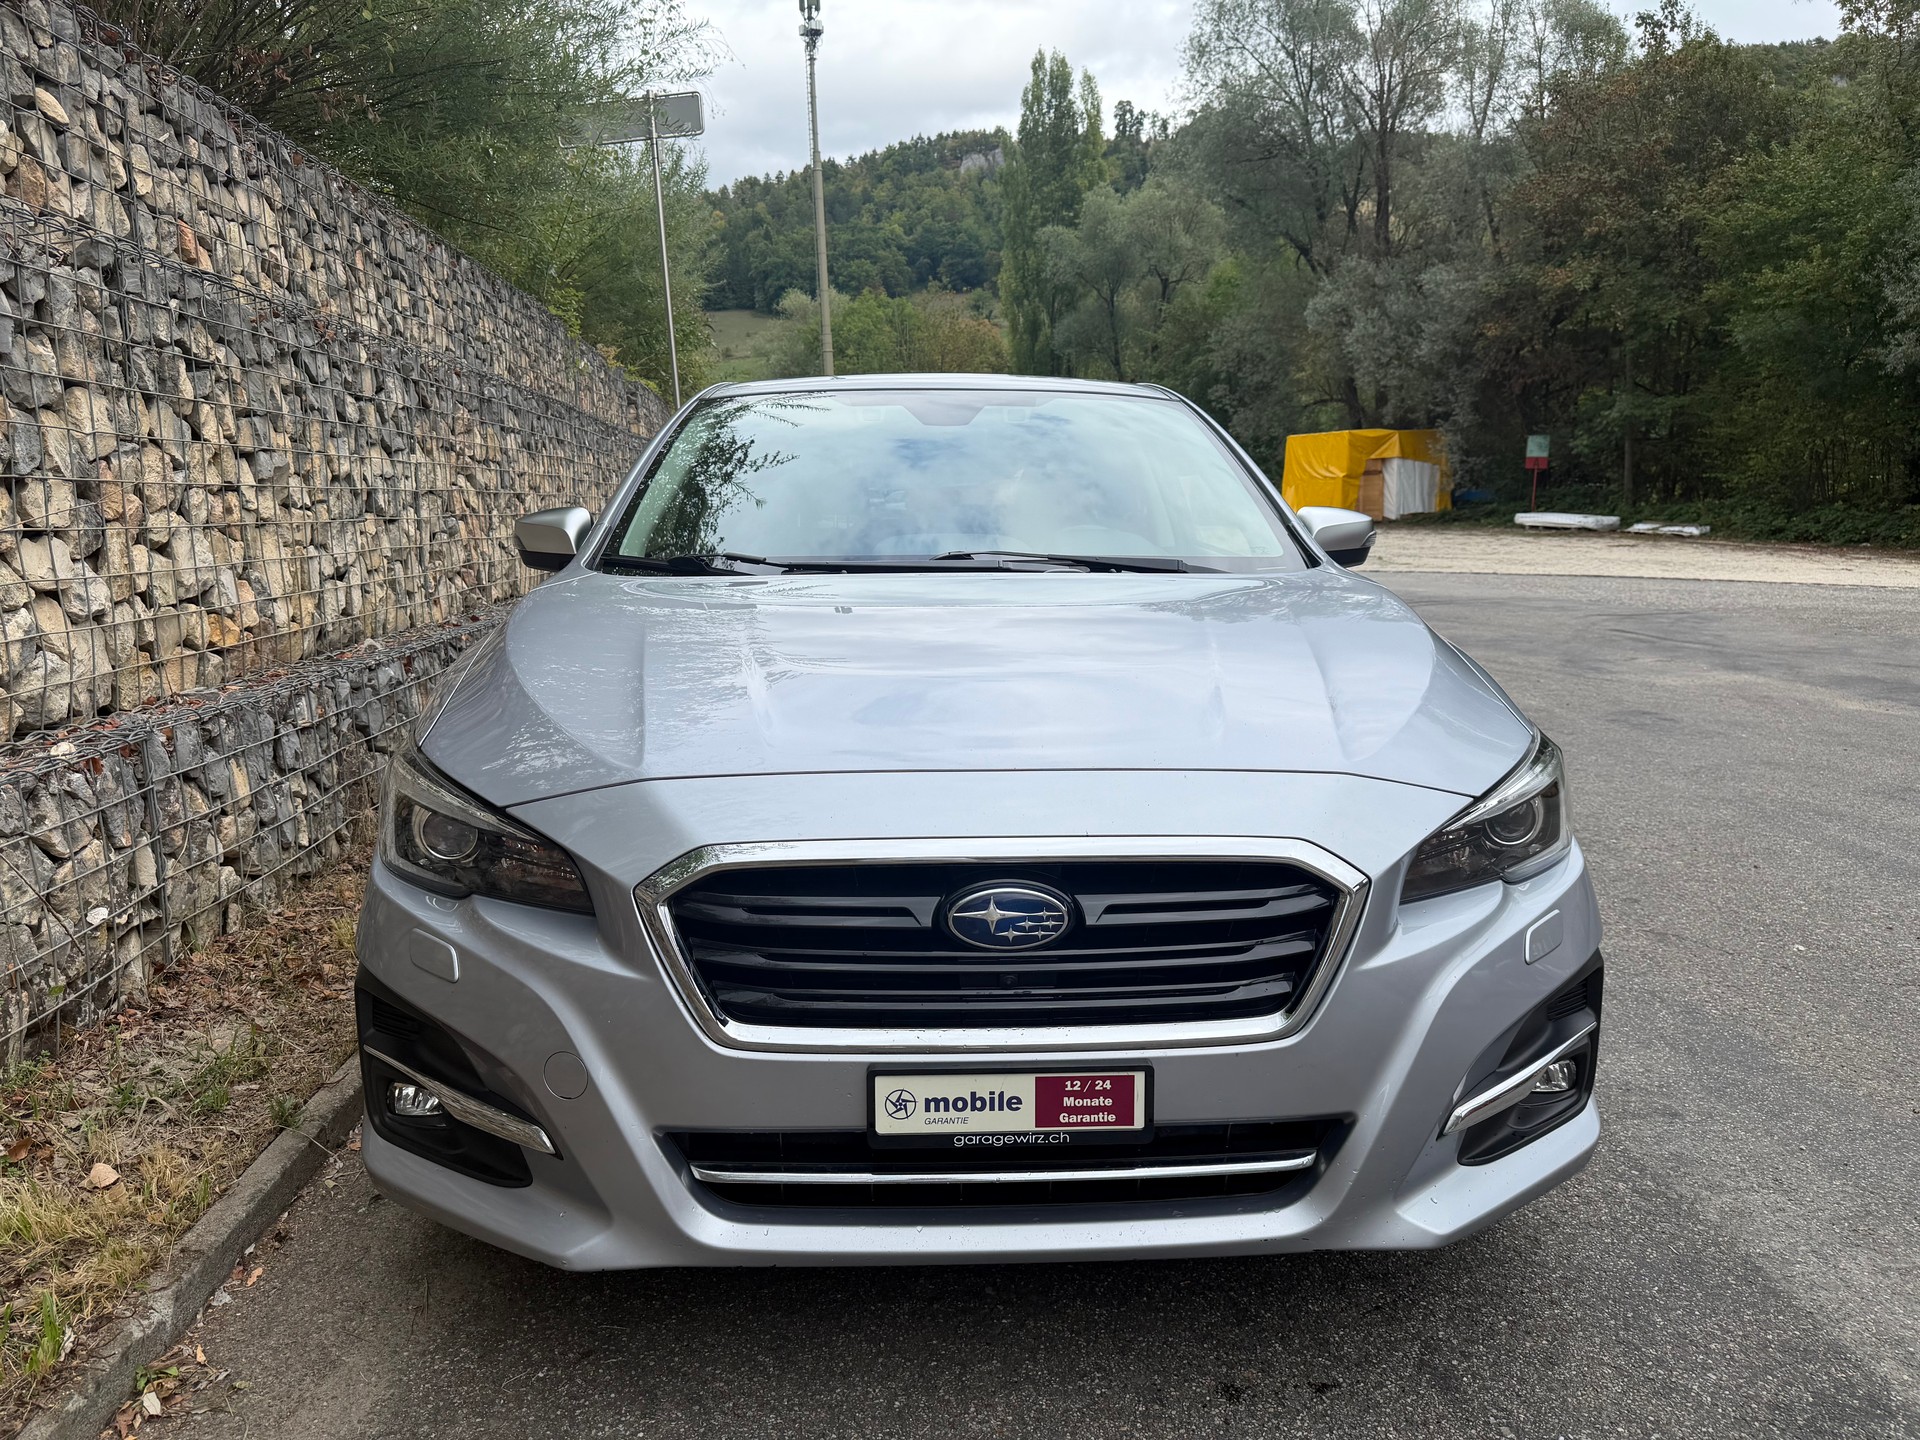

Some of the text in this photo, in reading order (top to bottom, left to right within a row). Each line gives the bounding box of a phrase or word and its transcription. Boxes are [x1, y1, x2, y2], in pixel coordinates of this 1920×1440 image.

[1065, 1080, 1081, 1091] 12
[1094, 1080, 1112, 1090] 24
[924, 1091, 1023, 1113] mobile
[1063, 1096, 1113, 1107] Monate
[924, 1116, 970, 1125] GARANTIE
[1059, 1112, 1117, 1123] Garantie
[953, 1132, 1070, 1147] garagewirz.ch
